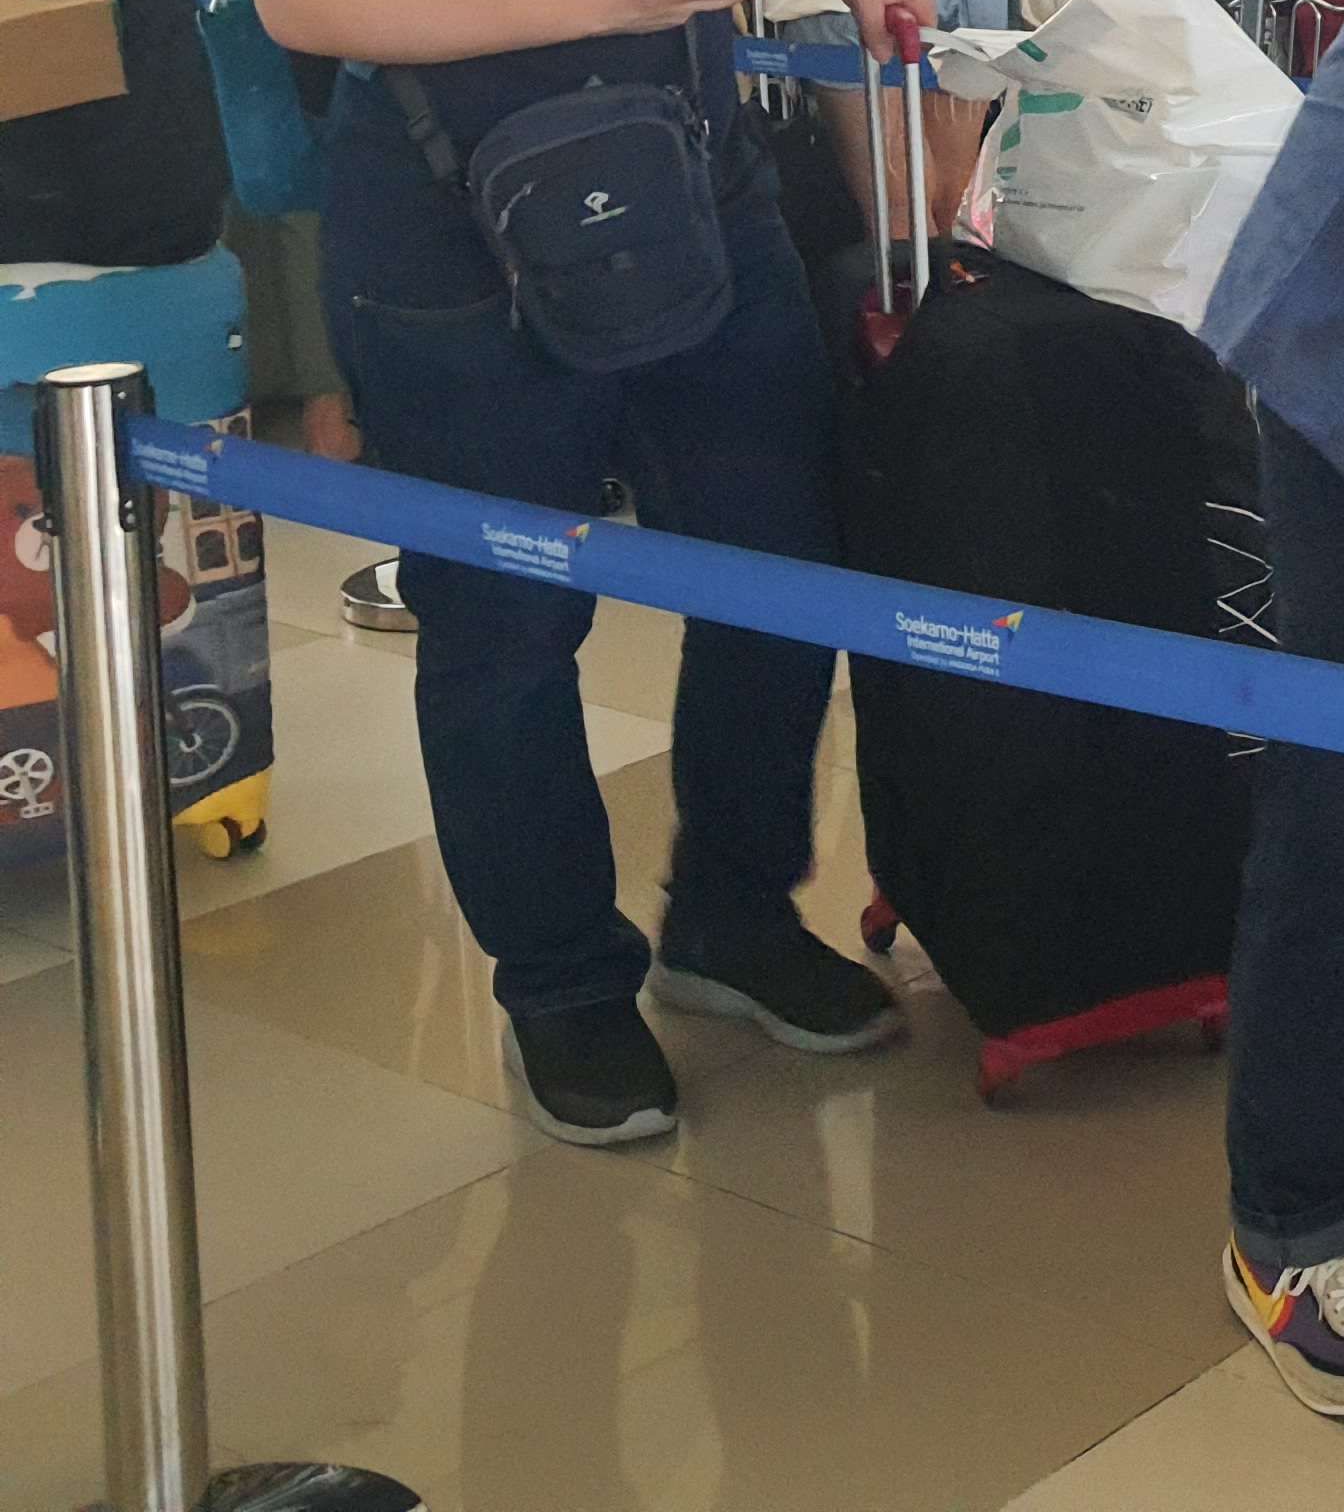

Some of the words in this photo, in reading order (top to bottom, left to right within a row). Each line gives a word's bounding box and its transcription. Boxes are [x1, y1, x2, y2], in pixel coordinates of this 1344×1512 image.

[895, 611, 1000, 650] Soekarno-Hatta
[906, 634, 965, 658] International
[966, 647, 1000, 666] Airport
